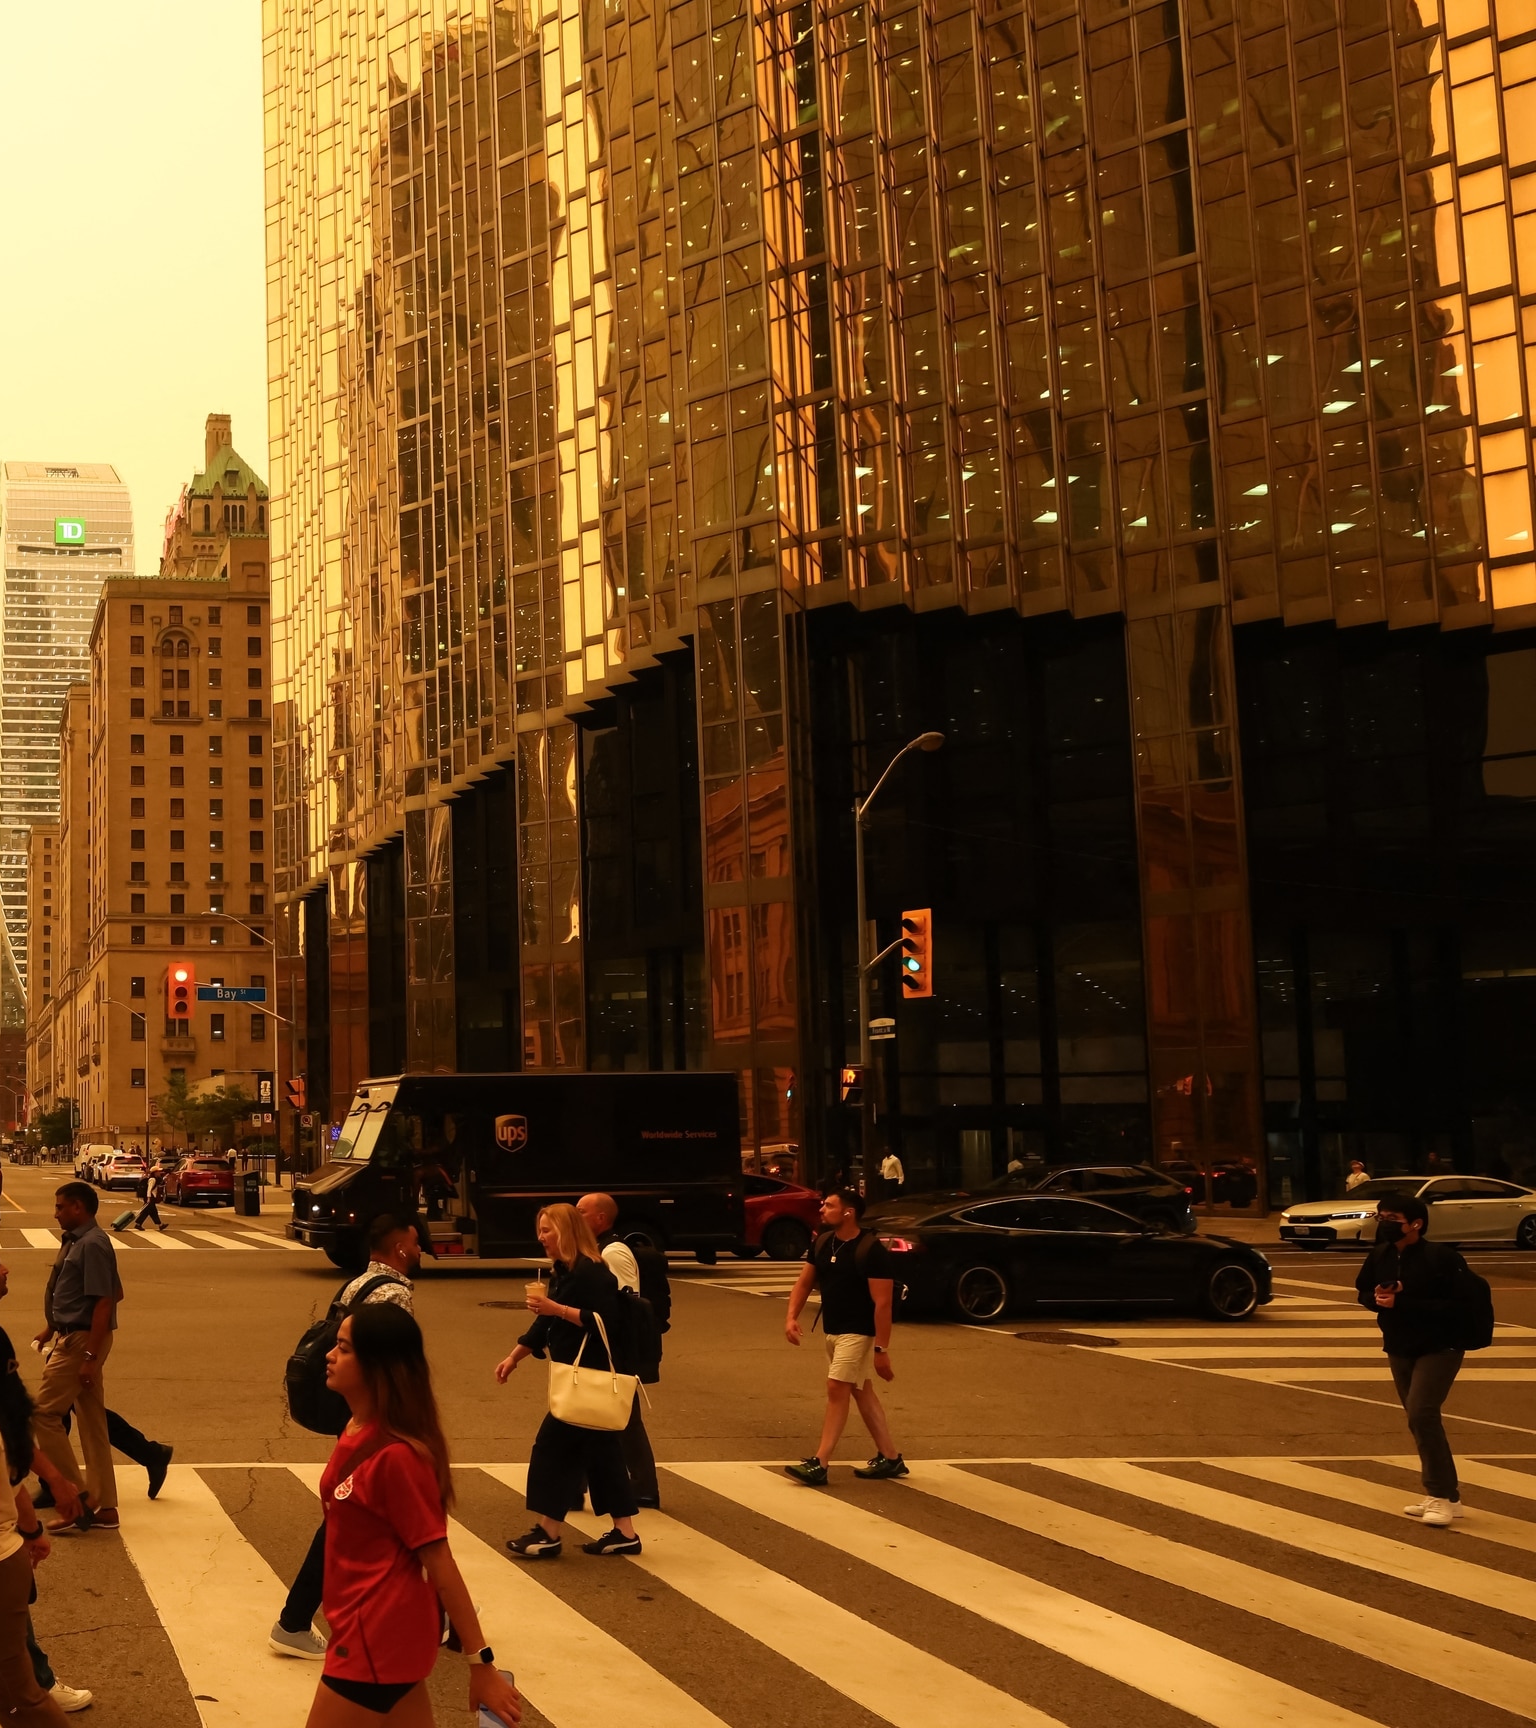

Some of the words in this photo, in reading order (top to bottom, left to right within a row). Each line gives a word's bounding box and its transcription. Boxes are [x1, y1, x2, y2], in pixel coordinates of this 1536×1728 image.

[58, 522, 83, 539] TD
[217, 988, 237, 1001] Bay
[497, 1126, 525, 1147] ups
[641, 1130, 683, 1139] Worldwide
[684, 1130, 717, 1139] Services
